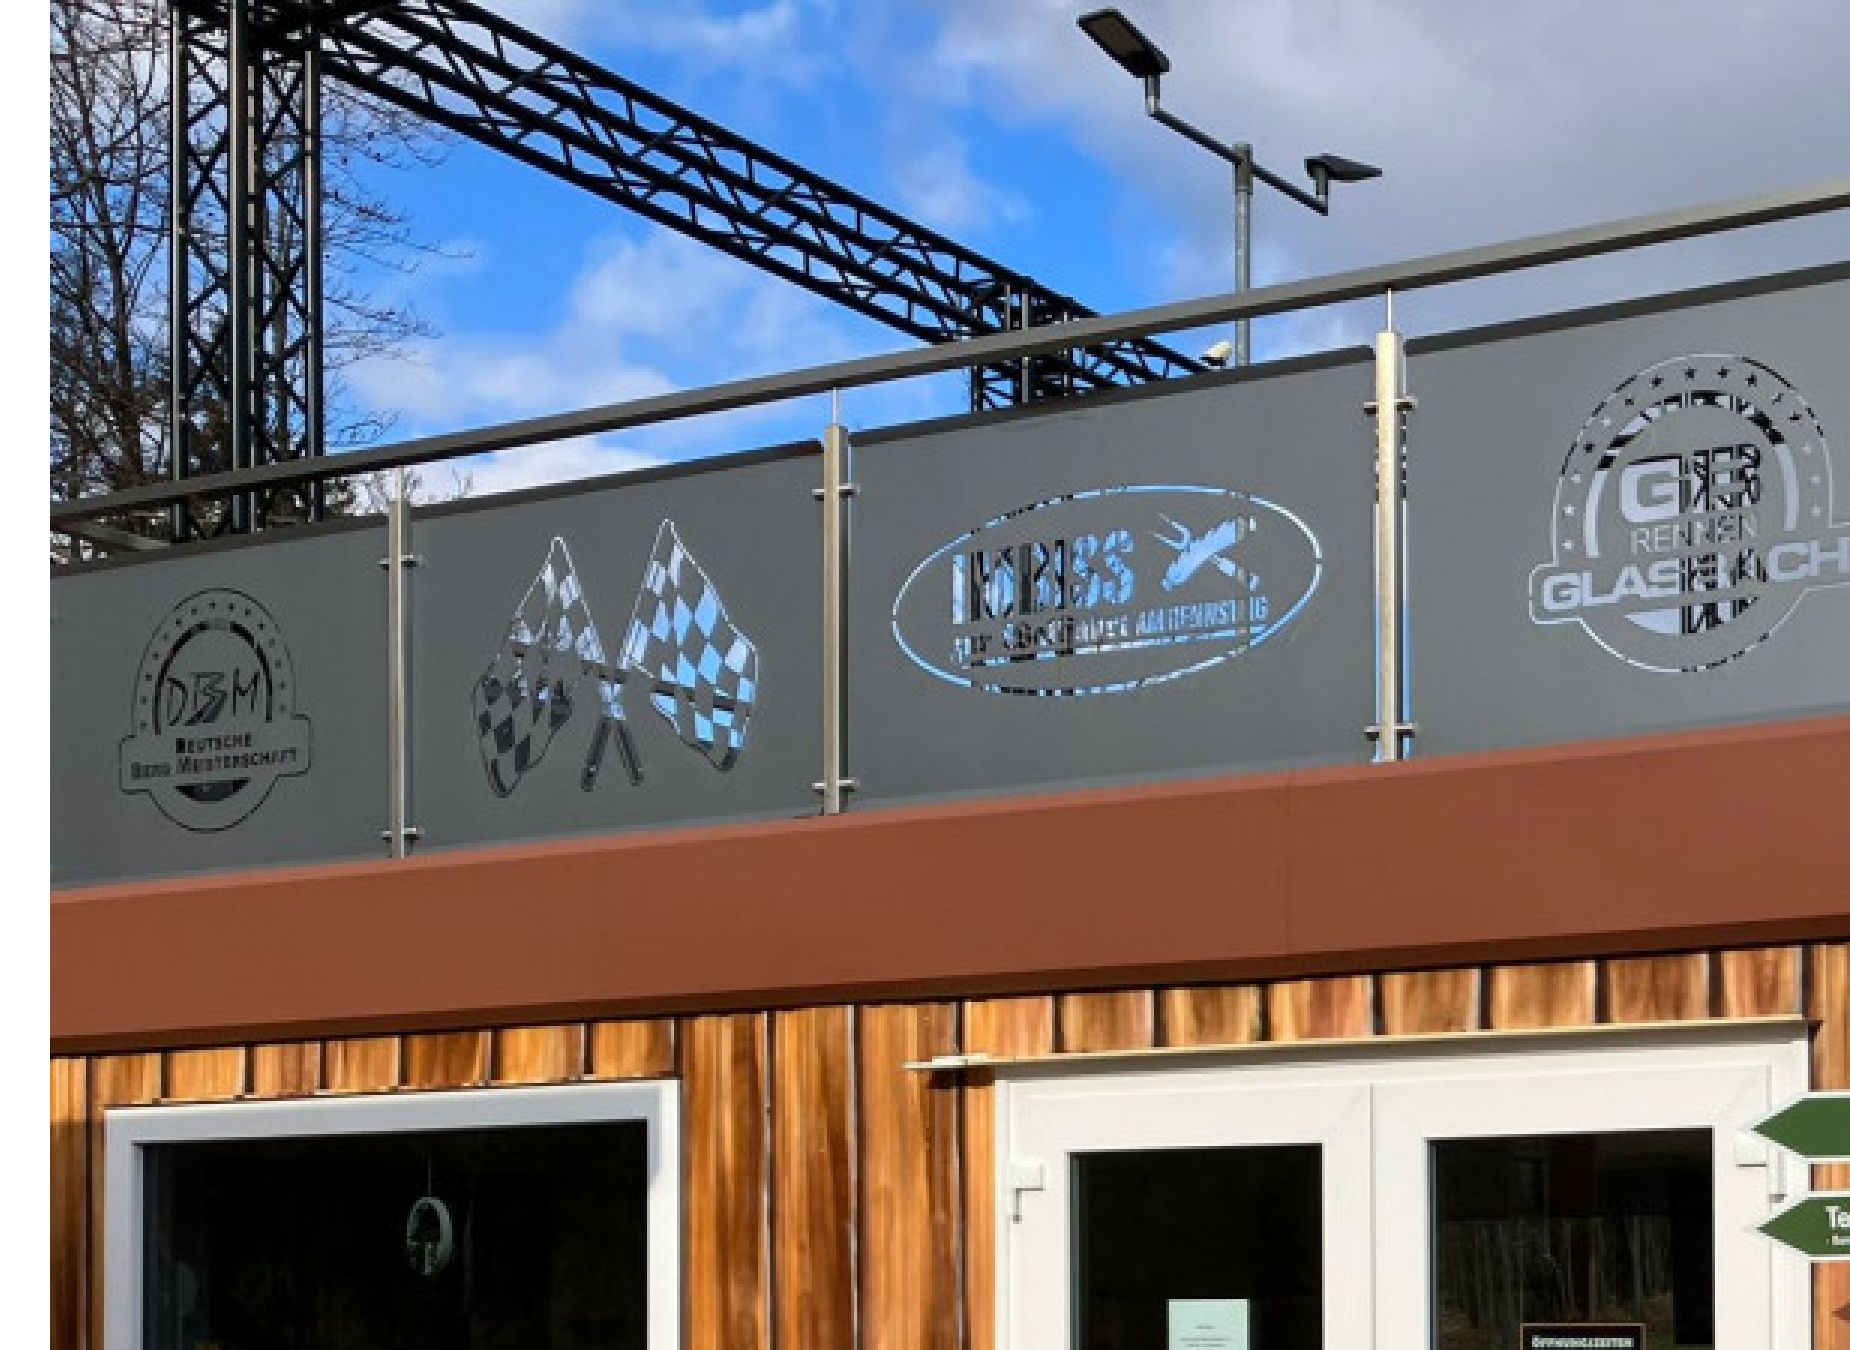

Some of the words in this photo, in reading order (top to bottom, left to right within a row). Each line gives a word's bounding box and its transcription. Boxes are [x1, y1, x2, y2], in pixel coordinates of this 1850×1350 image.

[1631, 513, 1758, 554] RENNEN
[1542, 535, 1850, 611] GLASBACH
[175, 732, 253, 754] DEUTSCHE
